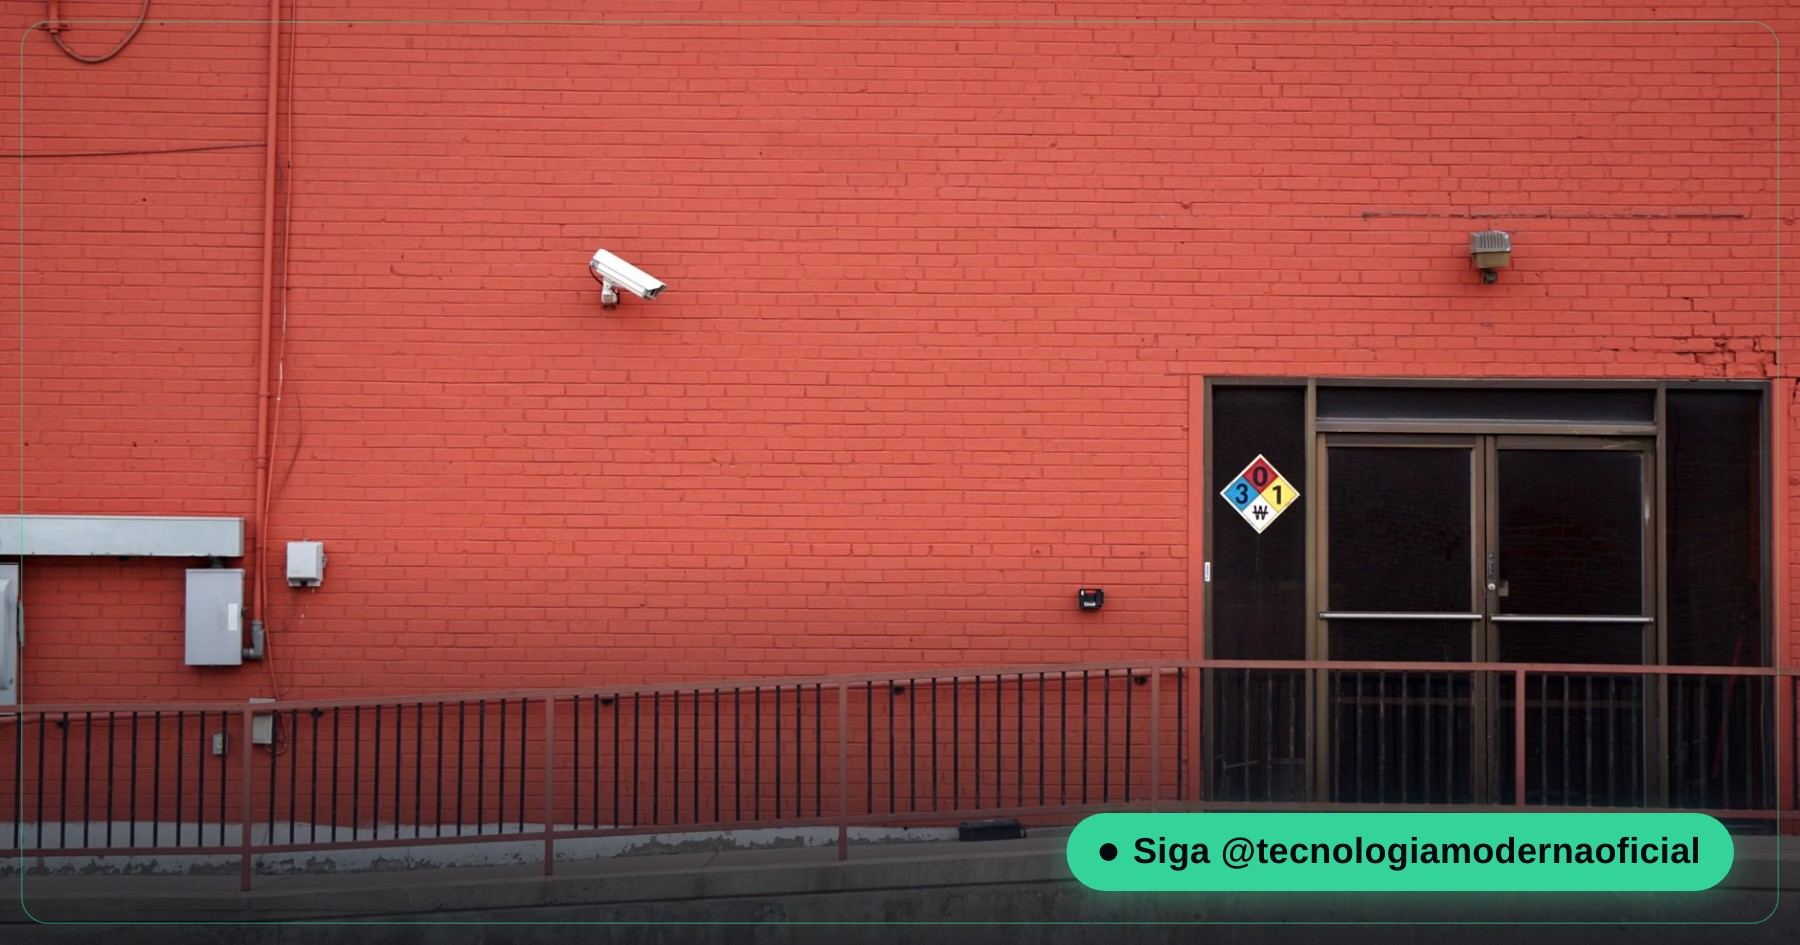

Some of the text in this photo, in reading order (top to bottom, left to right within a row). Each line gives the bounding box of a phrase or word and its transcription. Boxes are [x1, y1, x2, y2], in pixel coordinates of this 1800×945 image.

[1253, 466, 1268, 487] 0
[1235, 483, 1249, 504] 3
[1272, 485, 1282, 505] 1
